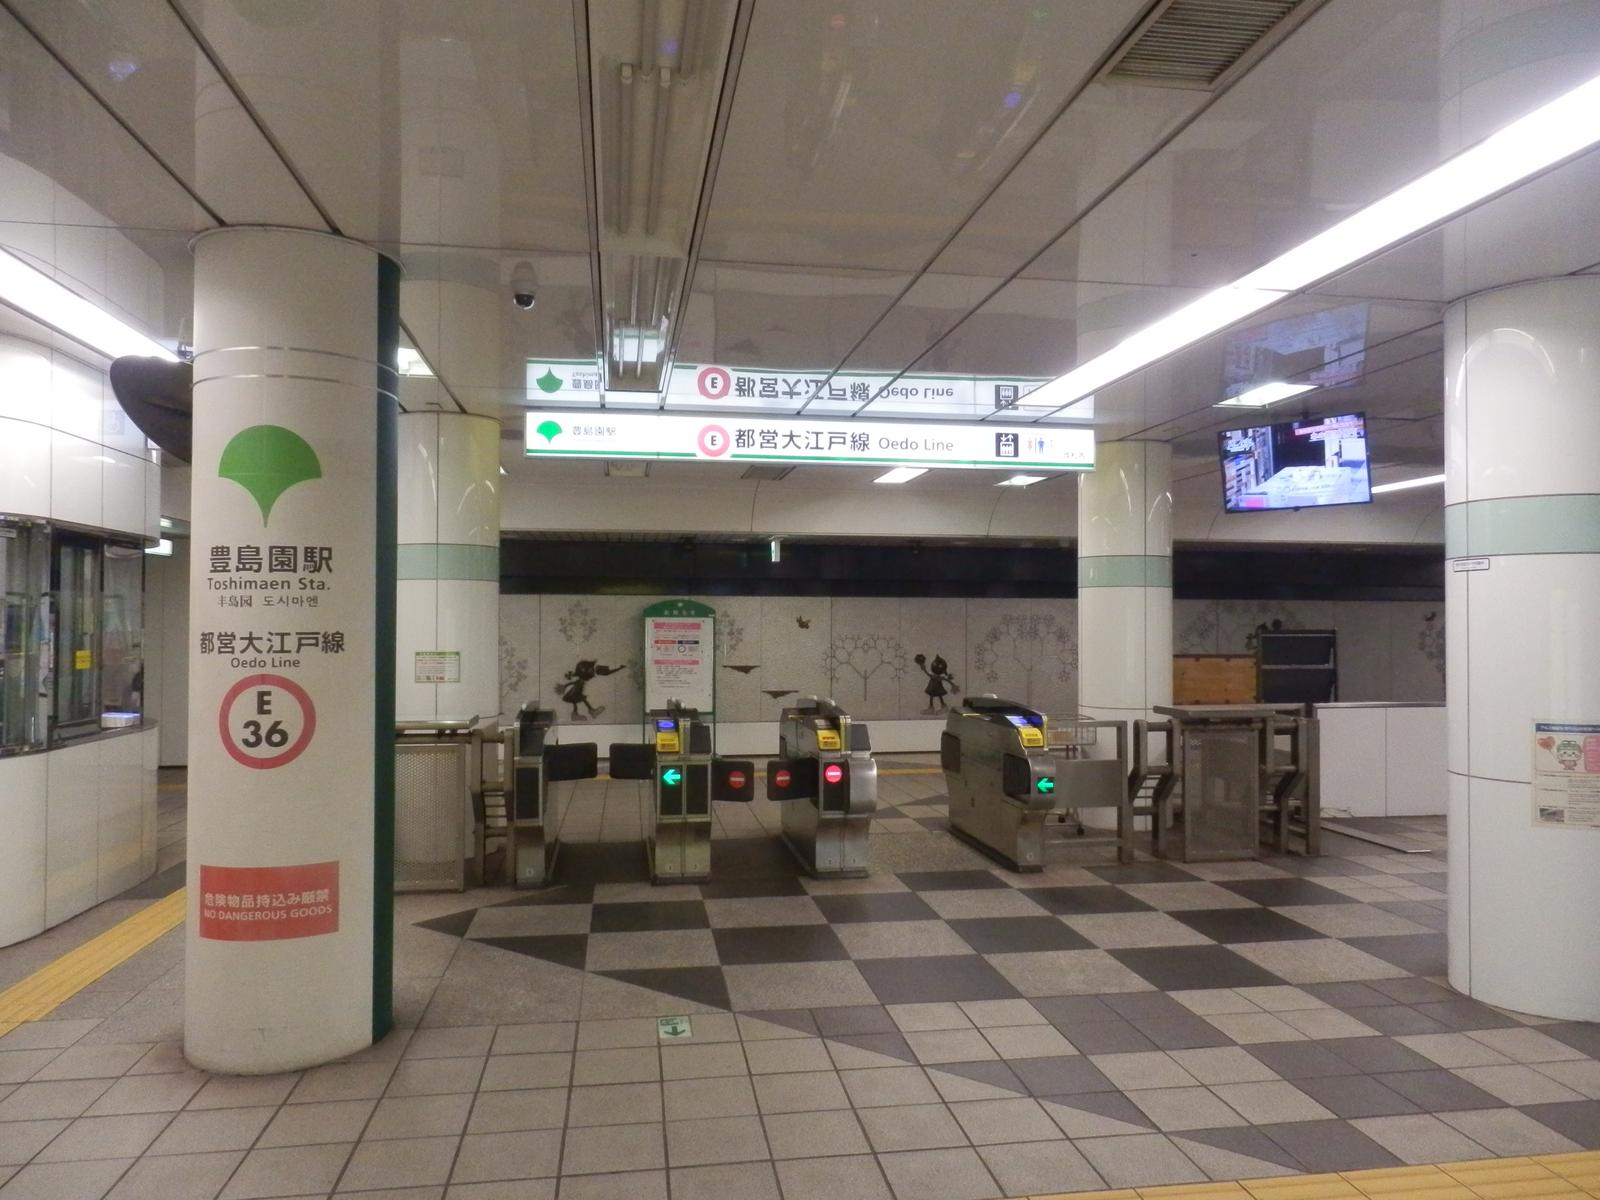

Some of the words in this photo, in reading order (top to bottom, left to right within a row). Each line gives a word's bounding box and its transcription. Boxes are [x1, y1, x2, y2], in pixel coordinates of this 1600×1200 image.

[710, 435, 717, 446] E
[735, 428, 870, 452] 都営大江戸線
[878, 437, 919, 451] Oedo
[924, 438, 954, 452] Line
[208, 544, 334, 575] 豊島園駅
[207, 576, 291, 591] Toshimaen
[298, 577, 331, 591] Sta.
[262, 595, 319, 608] 도시마엔
[200, 630, 345, 655] 都営大江戸線
[230, 656, 267, 669] Oedo
[271, 656, 301, 668] Line
[257, 690, 272, 715] E
[241, 719, 289, 749] 36
[204, 888, 330, 909] 危険物品持込み厳禁
[203, 908, 217, 920] NO
[218, 910, 288, 921] DANGEROUS
[290, 904, 333, 919] GOODS
